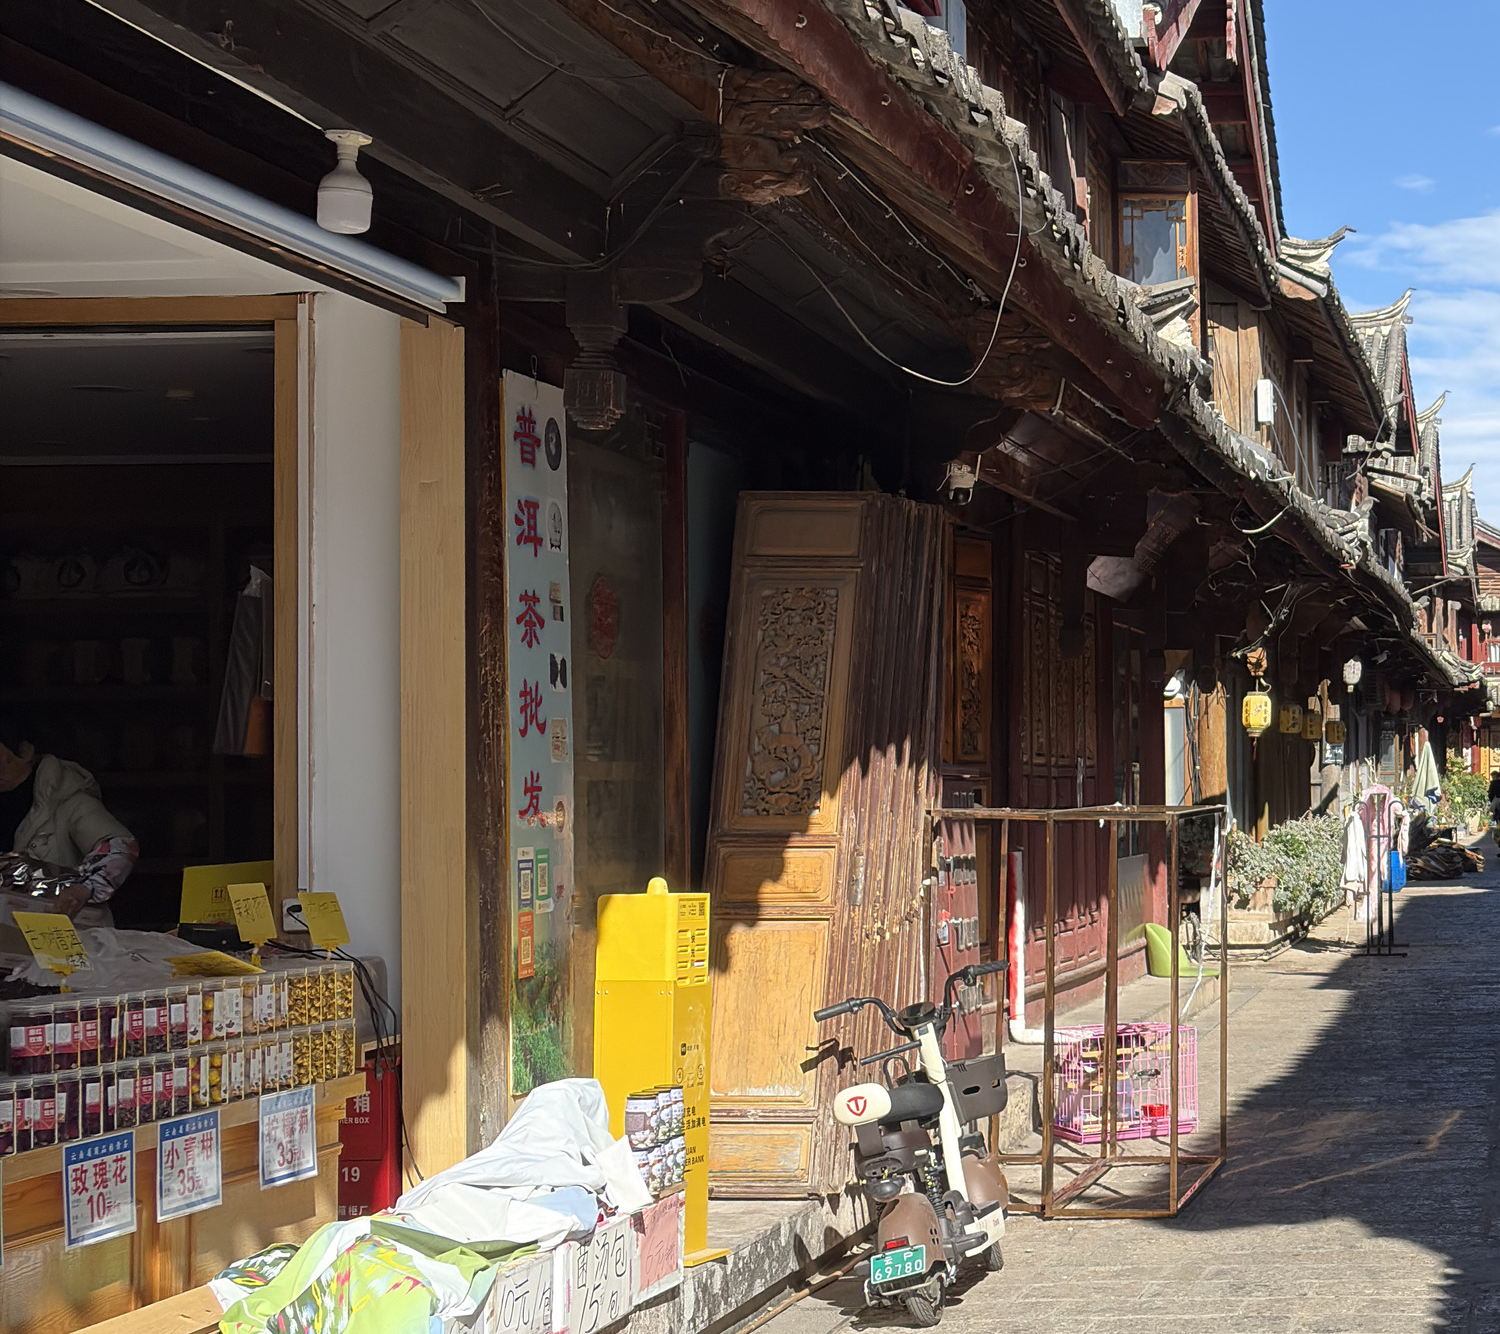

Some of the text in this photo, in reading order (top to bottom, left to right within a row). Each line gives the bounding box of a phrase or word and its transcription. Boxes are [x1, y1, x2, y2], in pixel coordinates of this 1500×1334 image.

[512, 406, 549, 828] 普洱茶批发
[165, 1131, 213, 1171] 小青柑
[692, 1155, 704, 1165] BANK
[72, 1155, 127, 1196] 玫瑰花
[577, 1229, 627, 1289] 菌汤包
[875, 1259, 922, 1280] 69780
[884, 1251, 913, 1265] 云 P
